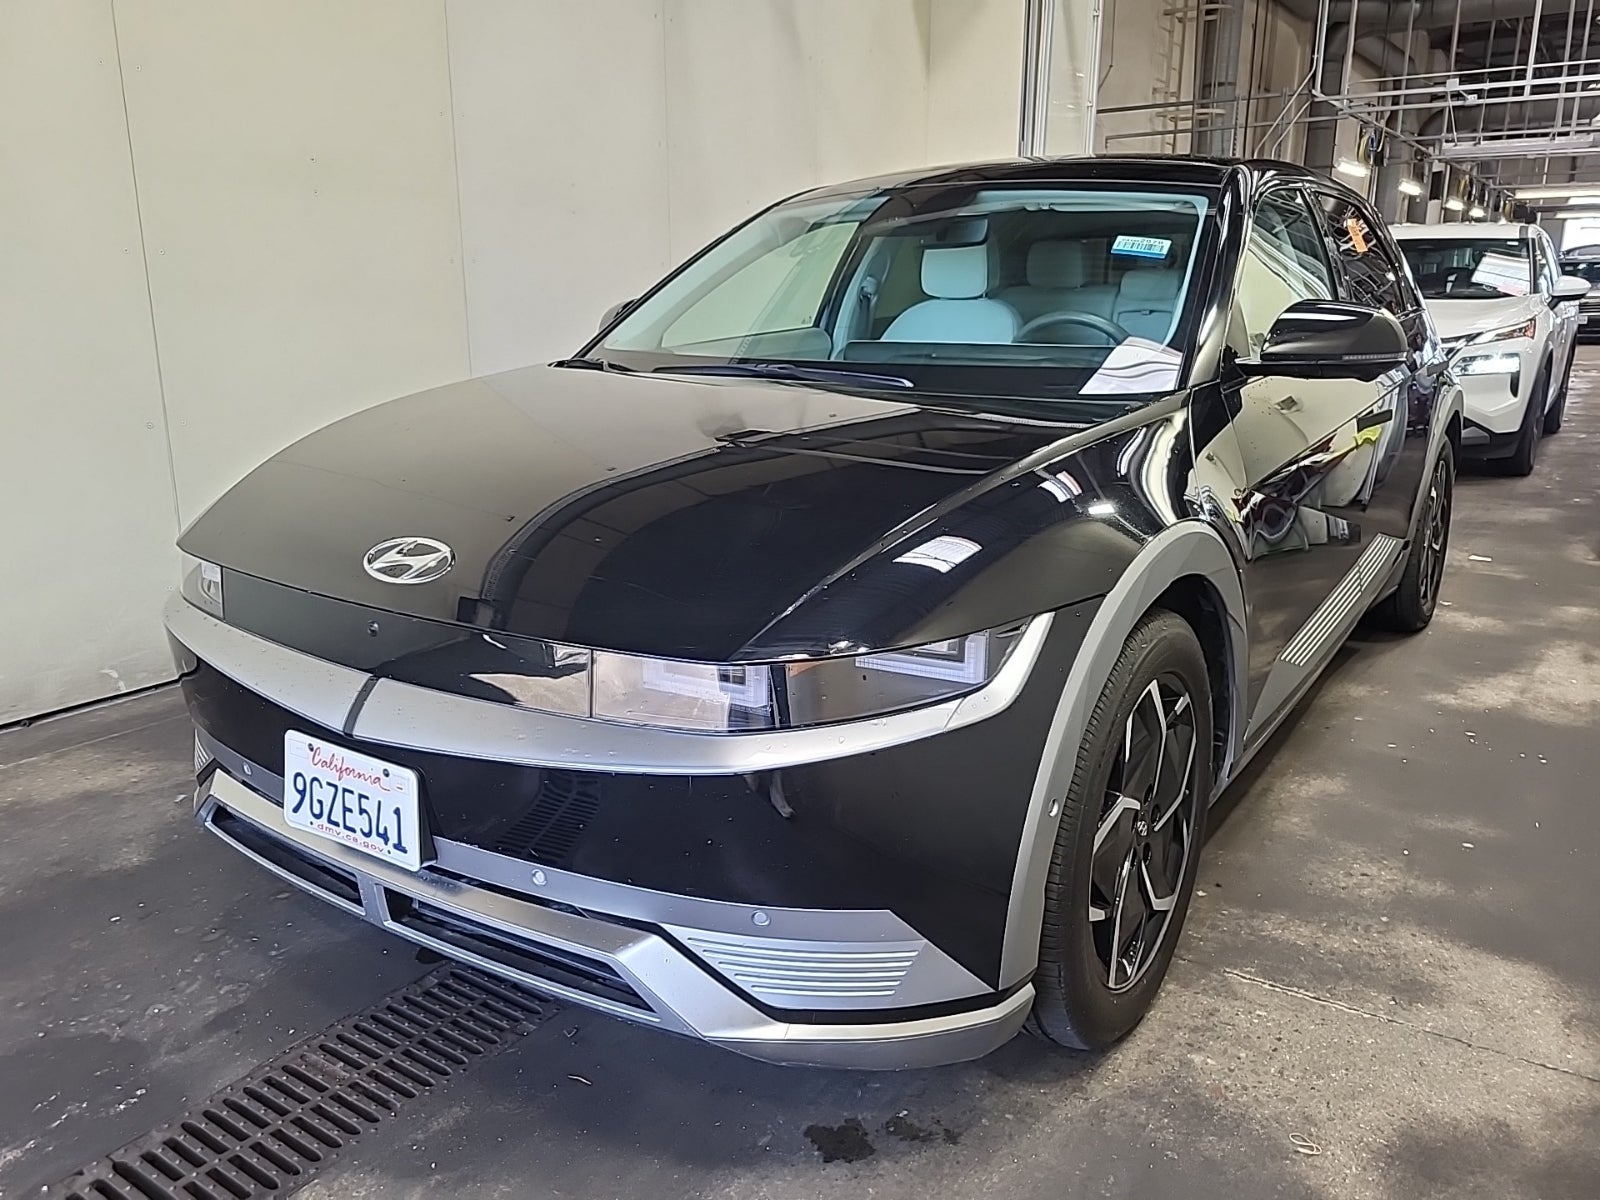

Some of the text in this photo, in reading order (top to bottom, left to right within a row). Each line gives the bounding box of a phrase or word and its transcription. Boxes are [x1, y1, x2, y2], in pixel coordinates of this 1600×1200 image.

[312, 747, 390, 791] California
[292, 772, 407, 853] 9GZE541
[317, 824, 384, 853] dmv.ca.gov
